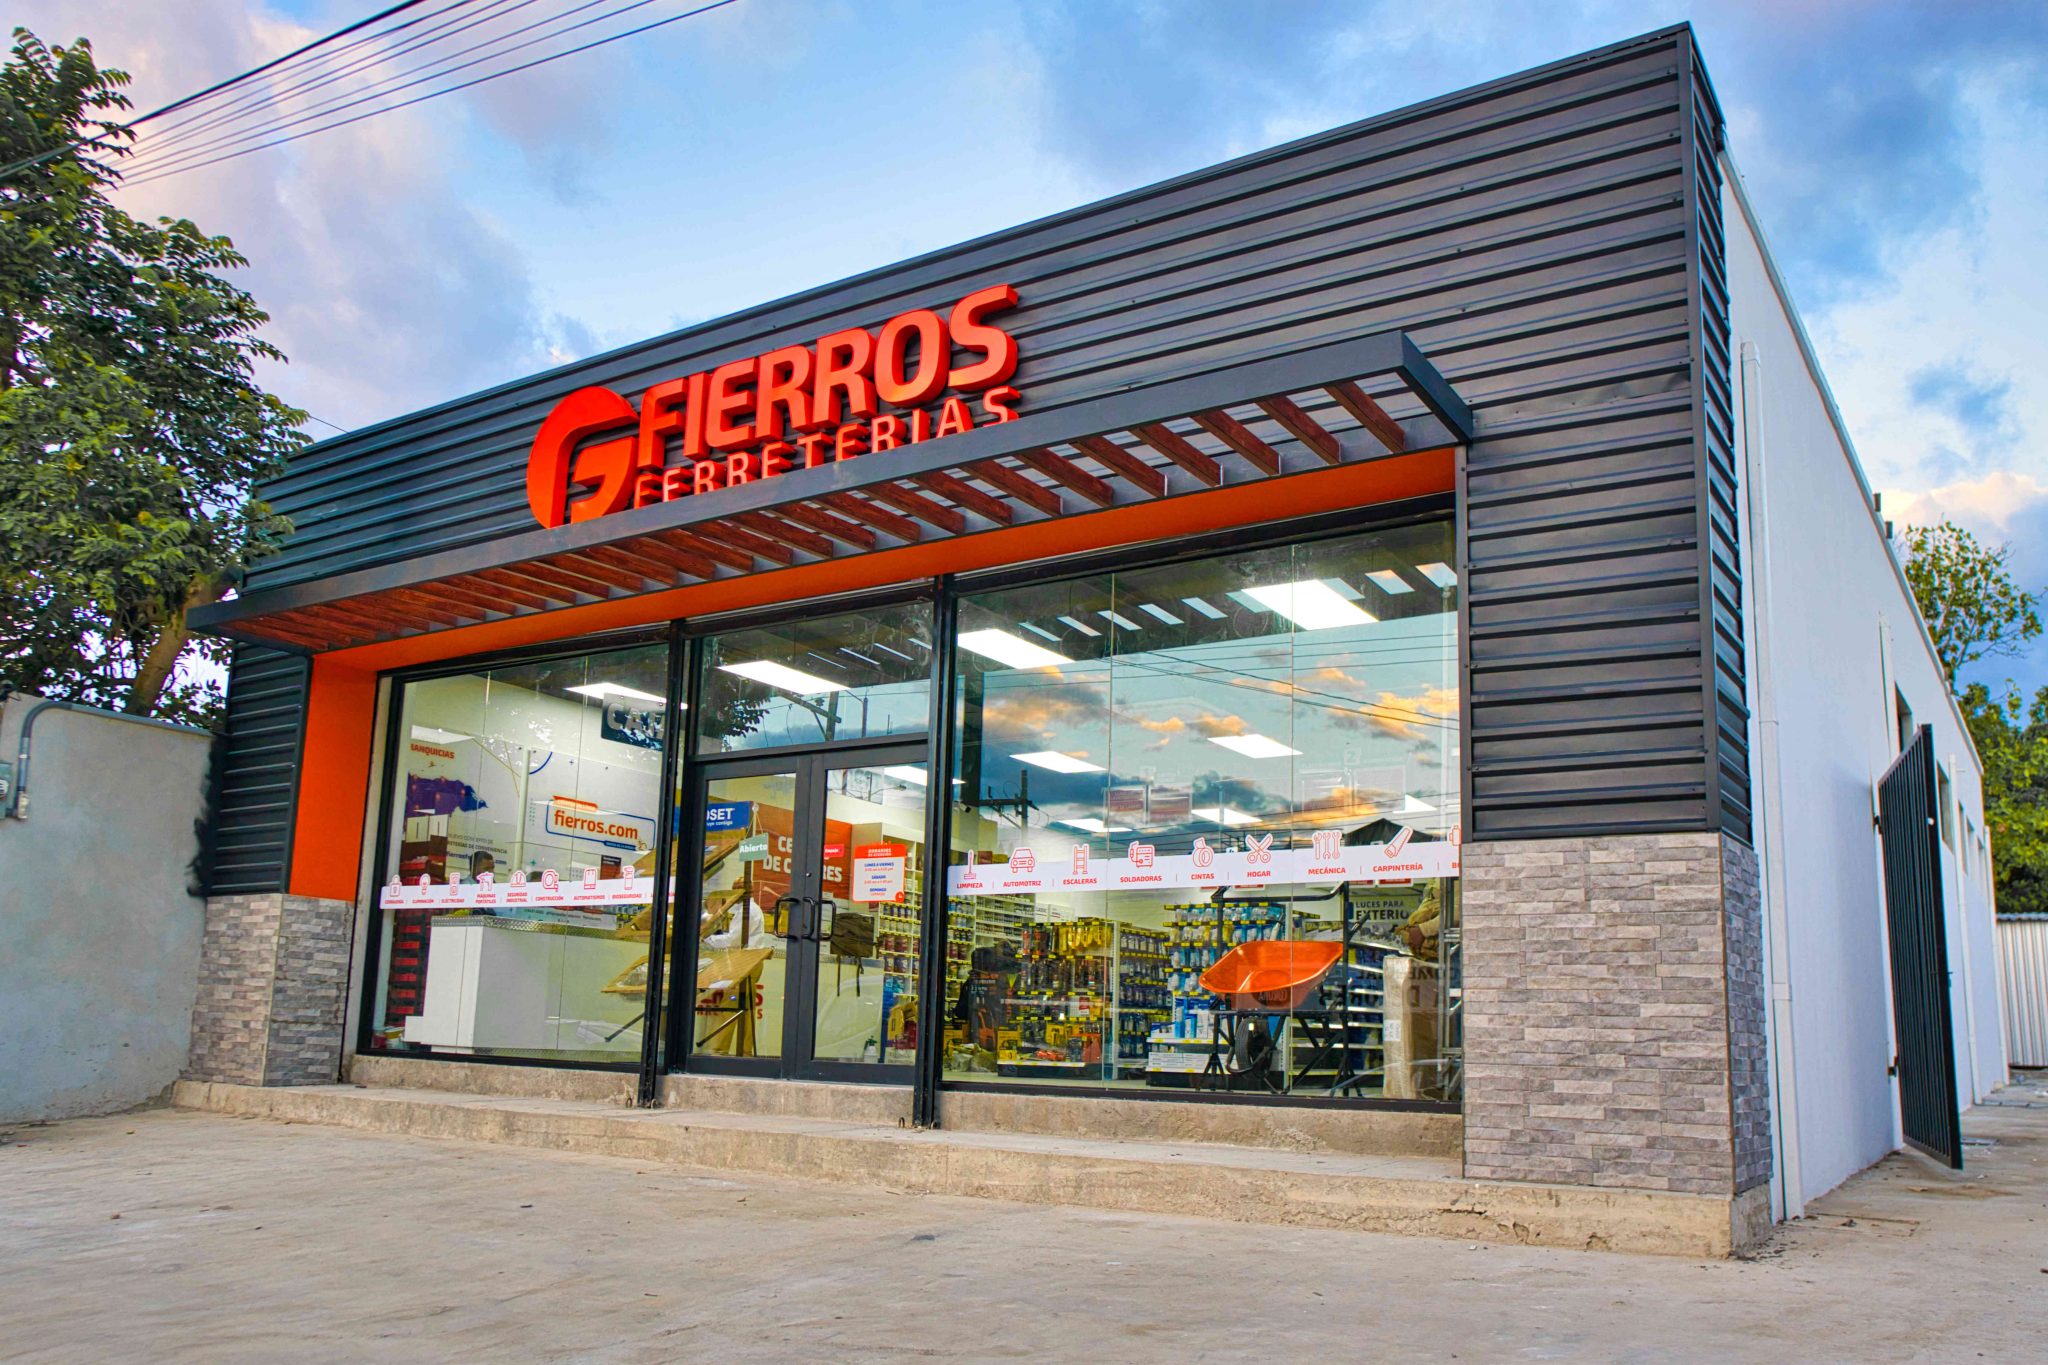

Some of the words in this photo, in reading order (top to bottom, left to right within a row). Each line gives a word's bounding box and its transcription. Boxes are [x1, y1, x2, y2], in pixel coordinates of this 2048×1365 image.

[638, 284, 1019, 470] FIERROS
[633, 386, 1020, 510] FERRETERIAS
[707, 808, 735, 820] SET
[554, 809, 638, 839] fierros.com
[740, 842, 767, 854] Abierto
[1308, 866, 1346, 875] MECÁNICA
[1372, 862, 1423, 872] CARPINTERÍA
[1120, 875, 1162, 883] SOLDADORAS
[1247, 870, 1271, 878] HOGAR
[1383, 900, 1404, 908] PARA
[1356, 909, 1410, 920] EXTERIO
